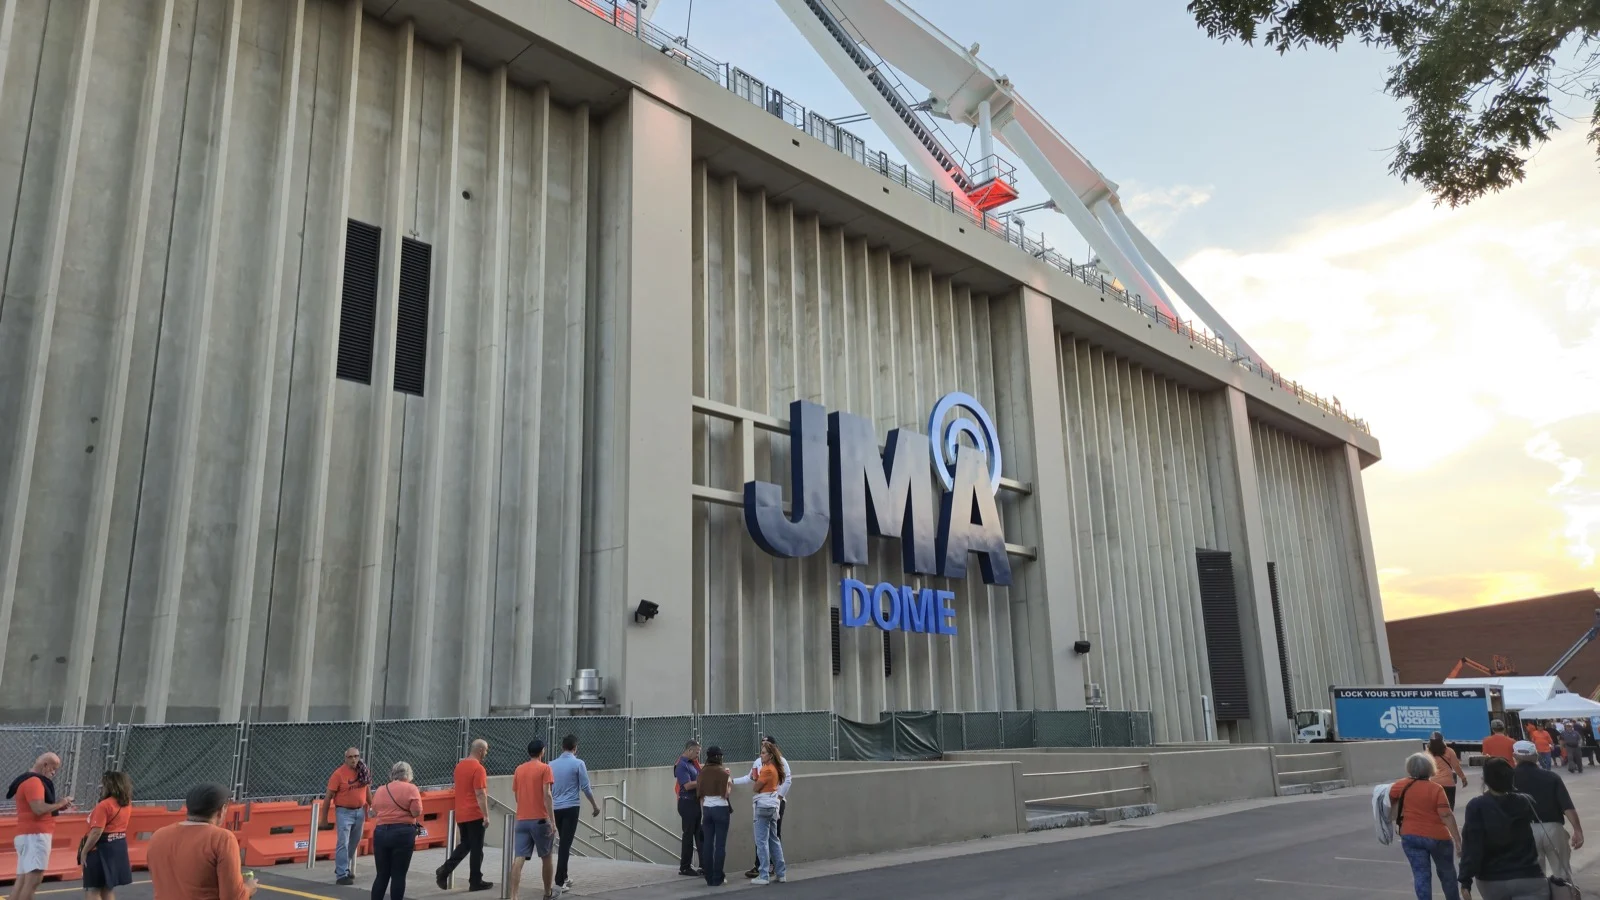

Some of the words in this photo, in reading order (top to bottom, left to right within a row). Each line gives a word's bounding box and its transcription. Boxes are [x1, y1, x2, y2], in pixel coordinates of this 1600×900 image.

[744, 399, 1013, 586] JMA
[841, 578, 957, 635] DOME
[1340, 690, 1363, 698] LOCK
[1365, 690, 1389, 698] YOUR
[1390, 690, 1418, 698] STUFF
[1420, 690, 1433, 698] UP
[1434, 690, 1459, 698] HERE
[1397, 710, 1440, 718] MOBILE
[1399, 717, 1441, 725] LOCKER
